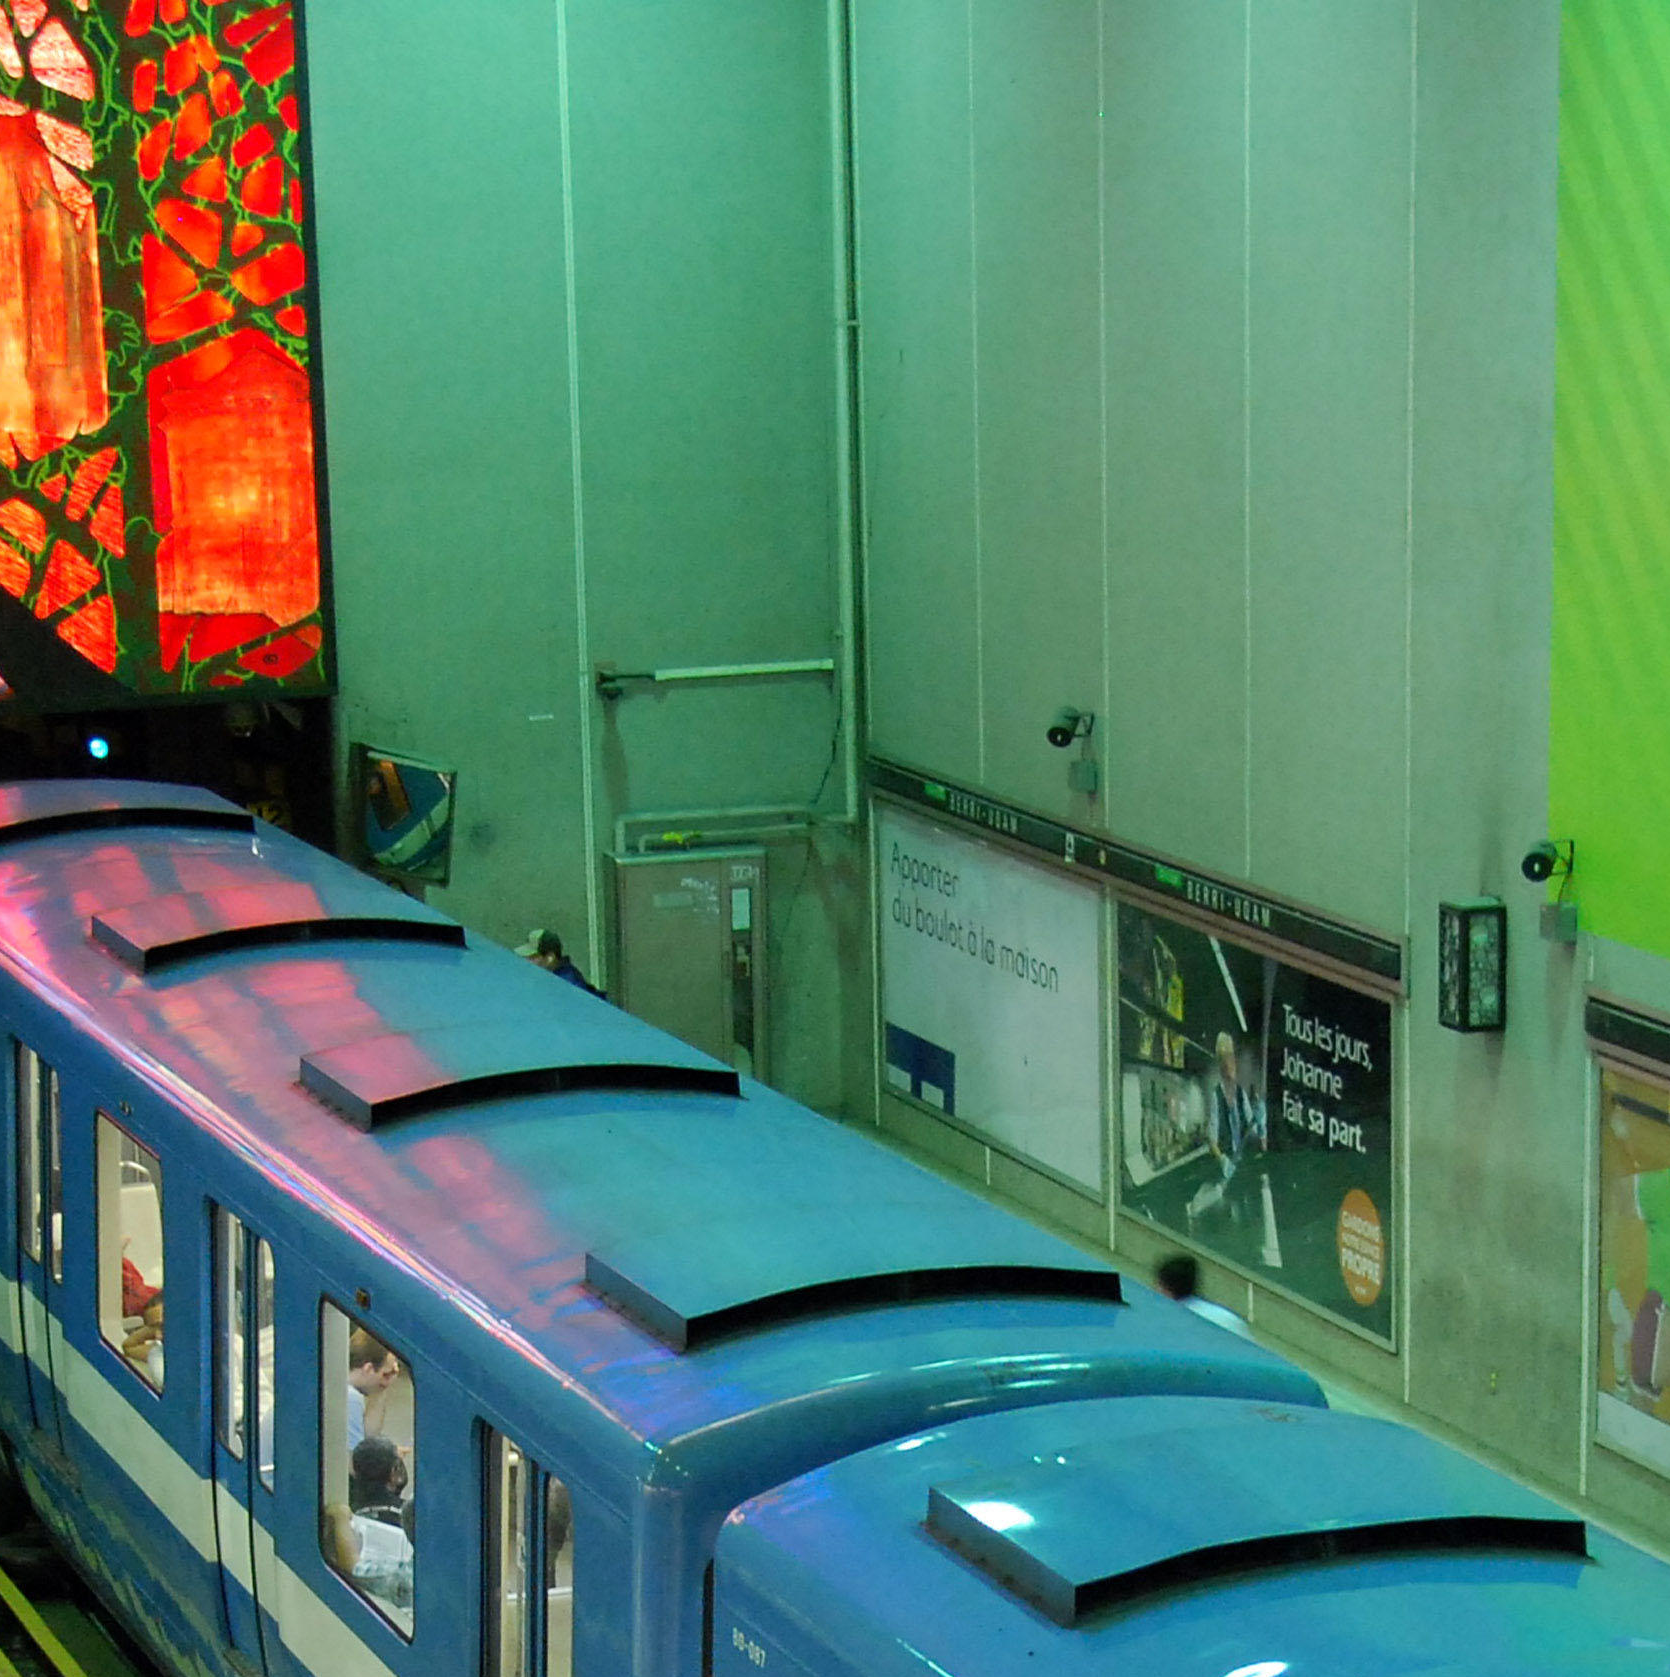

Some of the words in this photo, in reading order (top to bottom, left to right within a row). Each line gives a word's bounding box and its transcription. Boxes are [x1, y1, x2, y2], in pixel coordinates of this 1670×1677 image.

[950, 792, 1019, 834] BERRI-UQAM
[891, 841, 960, 898] Apporter
[1186, 880, 1271, 929] BERRI-UQAM
[892, 889, 912, 928] du
[915, 898, 964, 951] boulot
[967, 919, 978, 957] à
[980, 926, 995, 965] la
[999, 945, 1059, 993] maison
[1282, 1003, 1313, 1044] Tous
[1314, 1016, 1333, 1052] les
[1332, 1024, 1373, 1073] jours,
[1280, 1046, 1343, 1101] Johanne
[1282, 1089, 1304, 1128] fait
[1308, 1107, 1325, 1136] sa
[1329, 1116, 1367, 1154] part.
